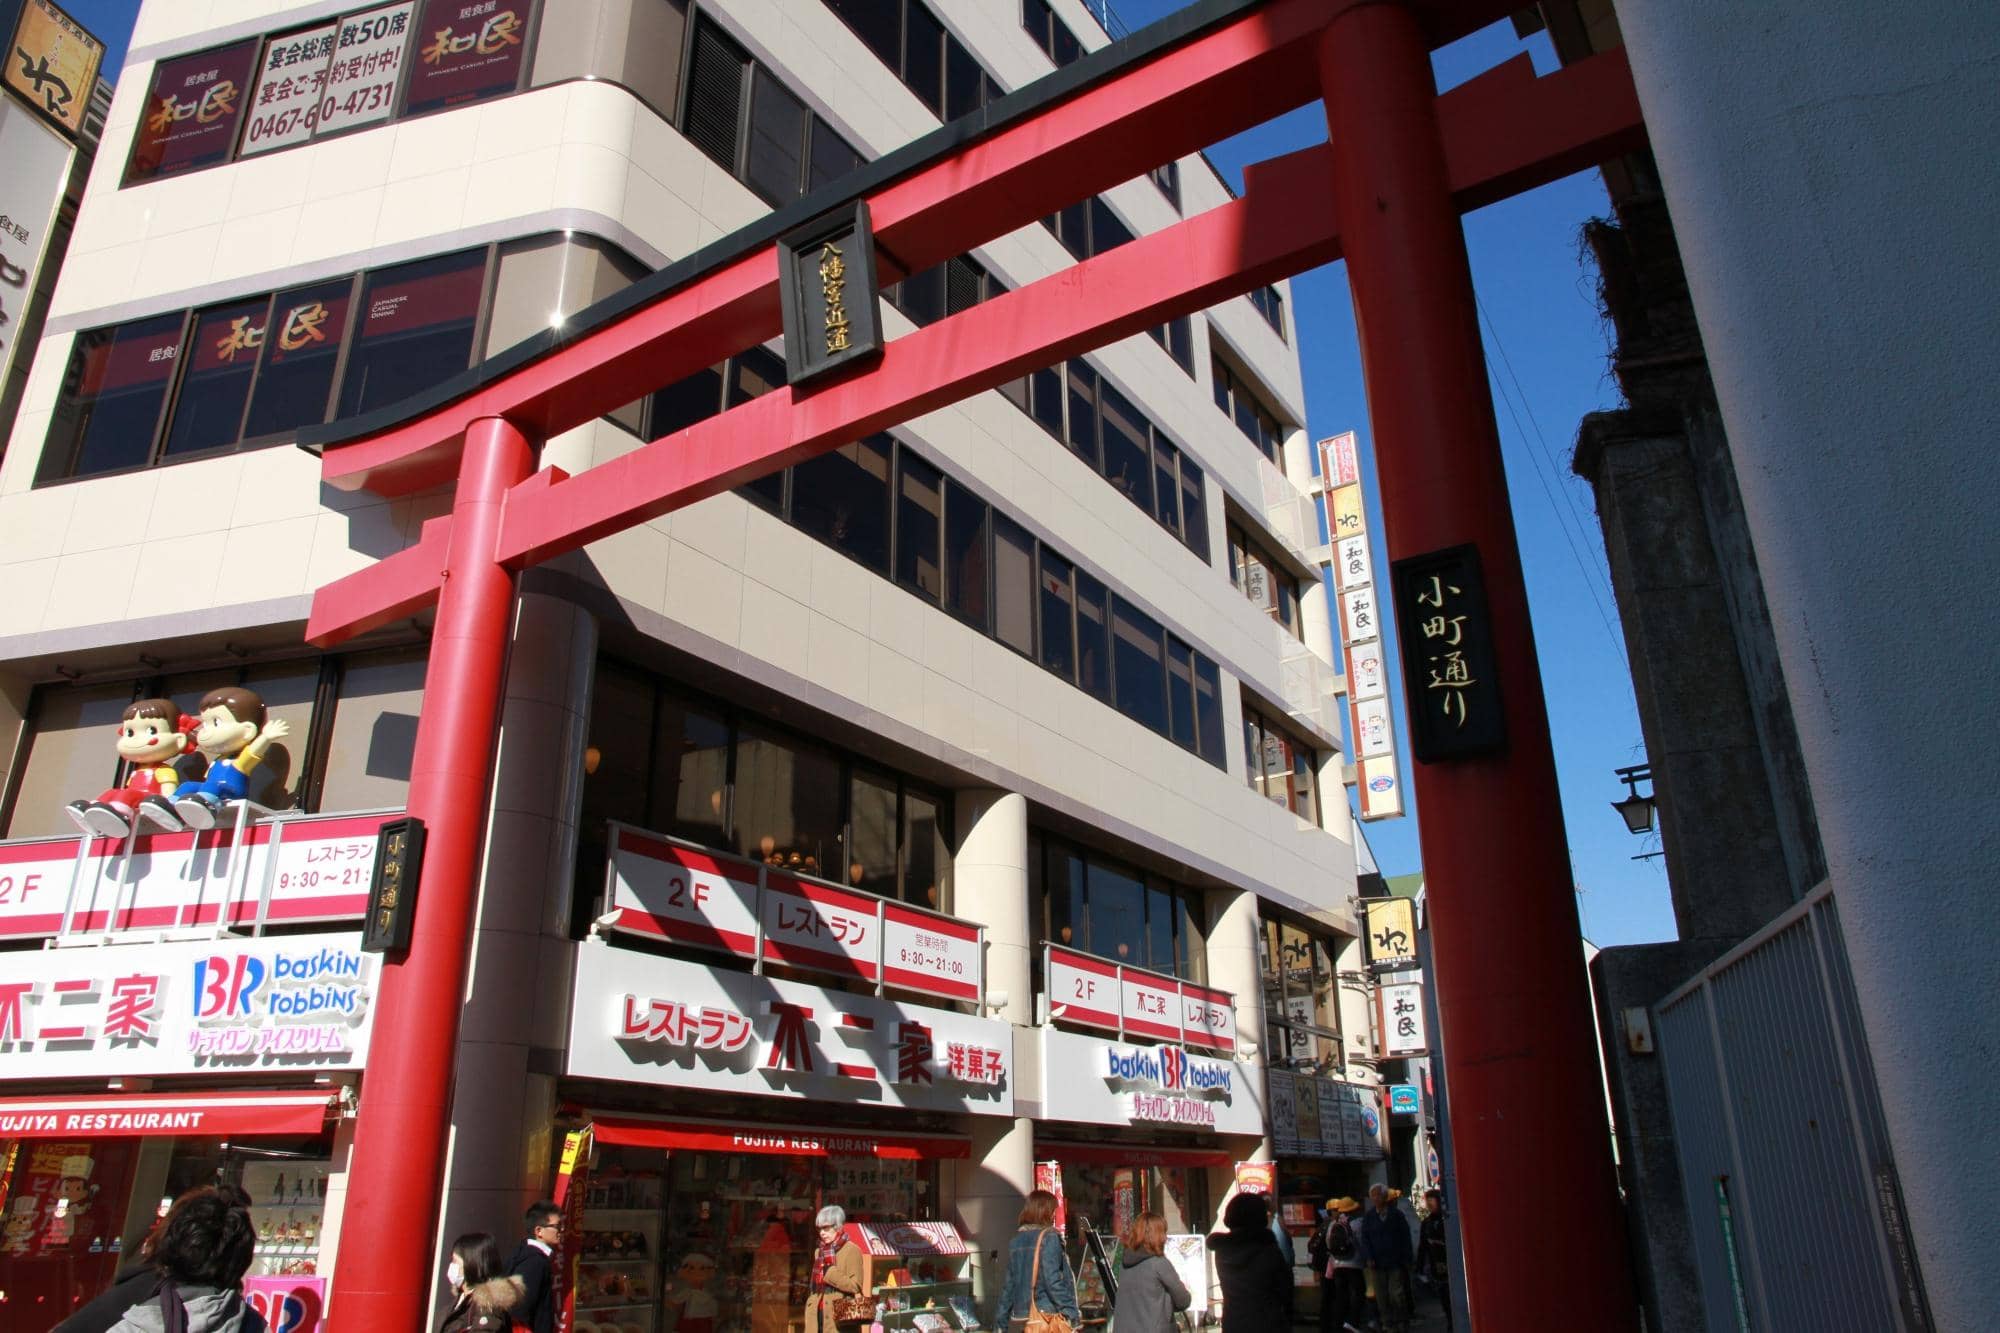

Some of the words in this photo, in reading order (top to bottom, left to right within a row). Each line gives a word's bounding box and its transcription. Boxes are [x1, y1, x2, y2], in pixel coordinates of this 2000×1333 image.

[422, 10, 522, 65] 和民
[150, 80, 239, 134] 和民
[217, 302, 328, 362] 和民
[149, 344, 178, 362] 居食
[1345, 547, 1365, 575] 和民
[1352, 600, 1371, 629] 和民
[1418, 576, 1477, 728] 小町通り
[307, 843, 374, 863] レストラン
[378, 835, 405, 937] 小町通り
[777, 901, 866, 946] レストラン
[1373, 926, 1409, 956] わん
[1136, 991, 1166, 1016] 不二家
[1187, 1004, 1227, 1028] レストラン
[1393, 998, 1417, 1037] 和民
[189, 1029, 251, 1052] サーティワン
[257, 1027, 342, 1051] アイスクリーム
[624, 996, 751, 1050] レストラン
[767, 1001, 933, 1085] 不二家
[946, 1042, 1003, 1083] 洋菓子
[0, 1113, 58, 1131] UJIYA
[65, 1110, 204, 1130] RESTAURANT
[1172, 1099, 1216, 1123] アイスクリーム
[734, 1133, 785, 1148] FUJIYA
[791, 1136, 879, 1153] RESTAURANT
